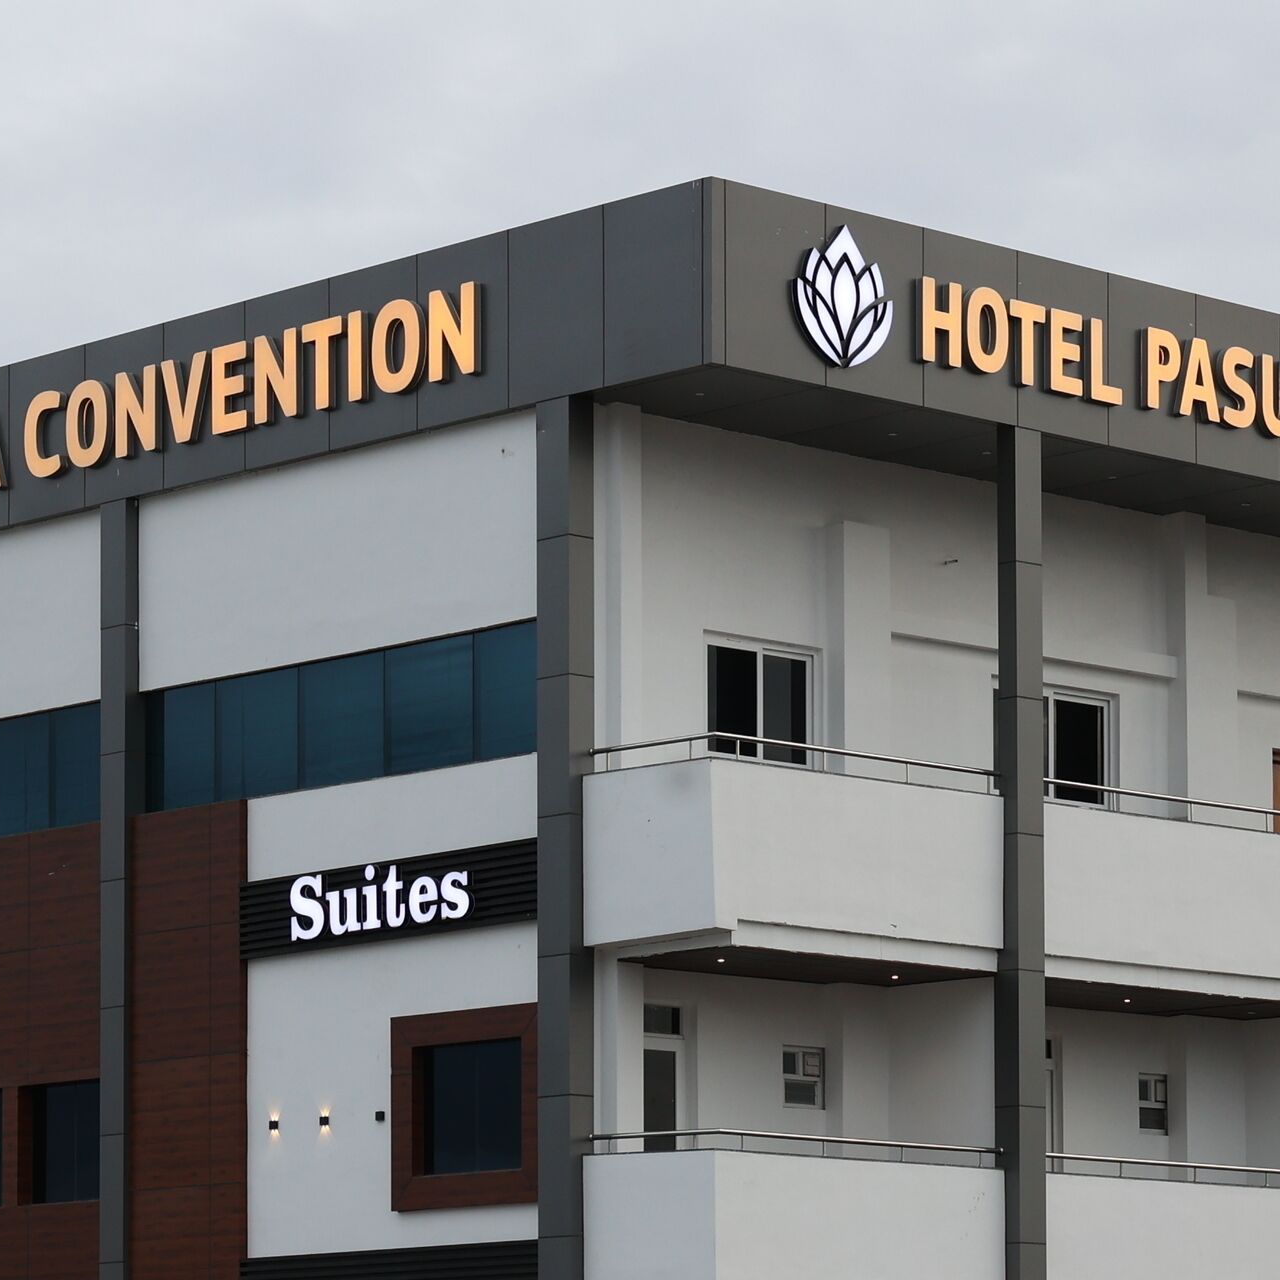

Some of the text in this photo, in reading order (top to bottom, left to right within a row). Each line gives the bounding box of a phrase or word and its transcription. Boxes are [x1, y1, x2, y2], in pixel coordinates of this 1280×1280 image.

[23, 280, 482, 479] CONVENTION
[919, 275, 1124, 407] HOTEL
[289, 864, 471, 942] Suites
